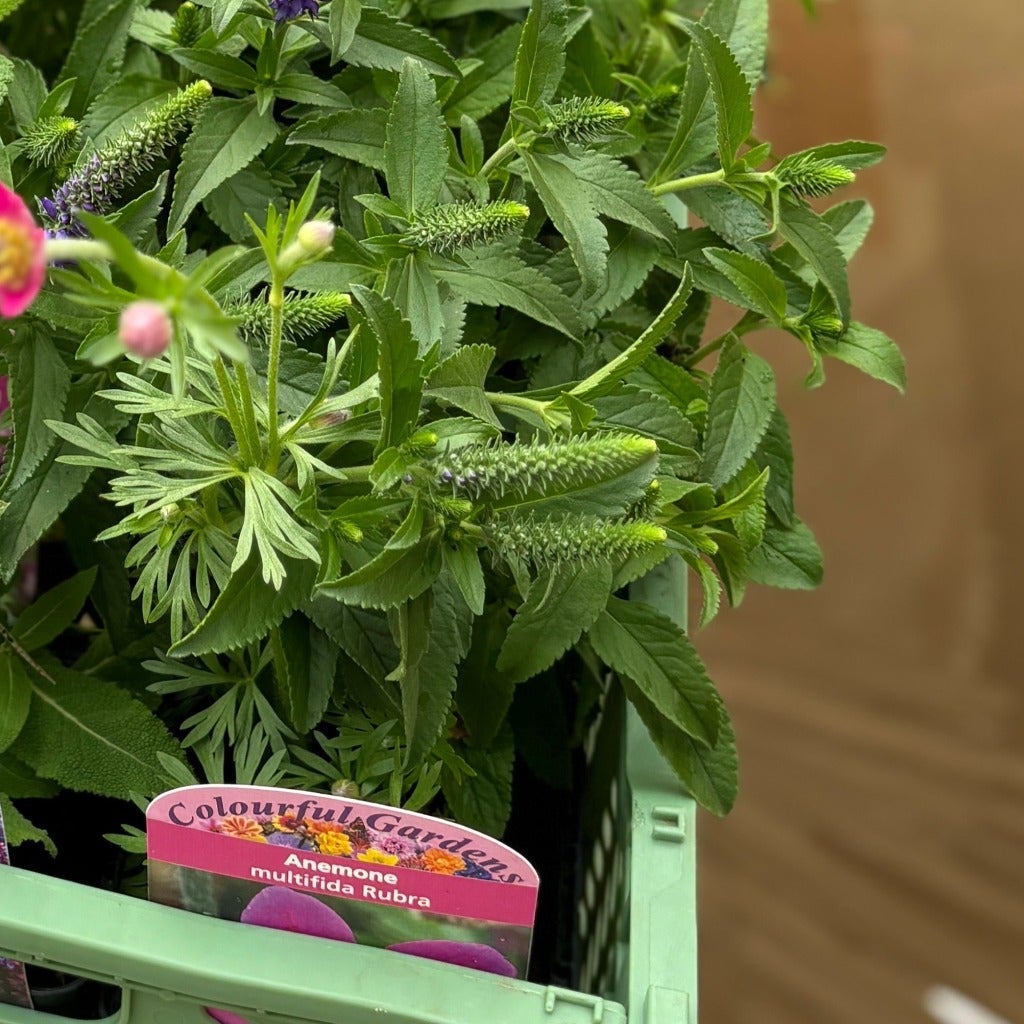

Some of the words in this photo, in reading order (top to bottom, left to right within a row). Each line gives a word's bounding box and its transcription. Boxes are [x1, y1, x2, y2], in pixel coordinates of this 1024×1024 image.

[168, 796, 352, 827] Colourful
[366, 813, 525, 885] Gardens
[250, 864, 355, 896] multifida
[363, 884, 431, 908] Rubra
[283, 852, 399, 885] Anemone
